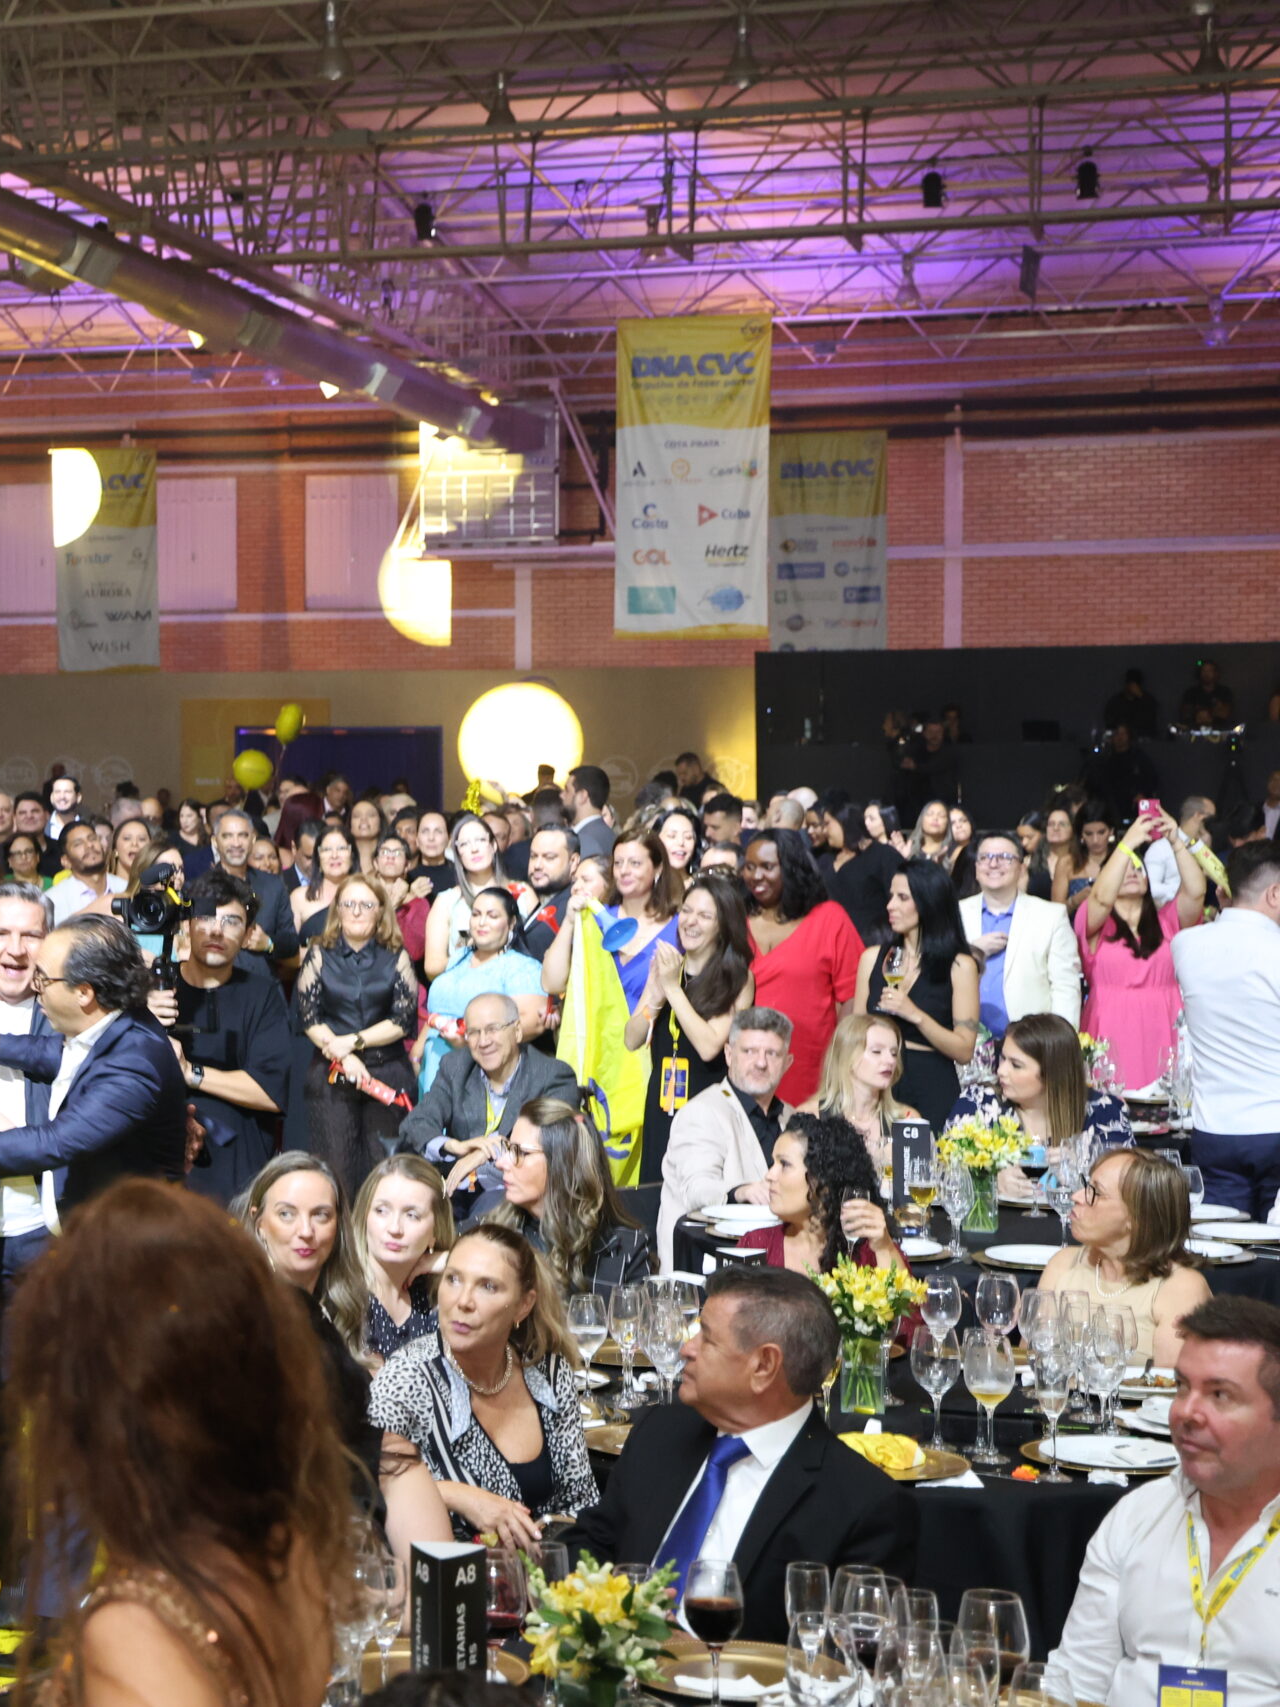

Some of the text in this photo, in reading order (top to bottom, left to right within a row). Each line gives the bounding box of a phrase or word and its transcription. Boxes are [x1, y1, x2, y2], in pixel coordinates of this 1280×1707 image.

[721, 507, 751, 520] Cuba
[631, 518, 669, 529] Costa
[632, 549, 671, 566] GOL
[705, 543, 749, 558] Hertz
[84, 588, 132, 598] AURORA
[88, 640, 131, 654] WISH
[903, 1126, 919, 1139] C8
[415, 1560, 430, 1584] A8
[455, 1563, 477, 1588] A8
[468, 1642, 478, 1666] RS
